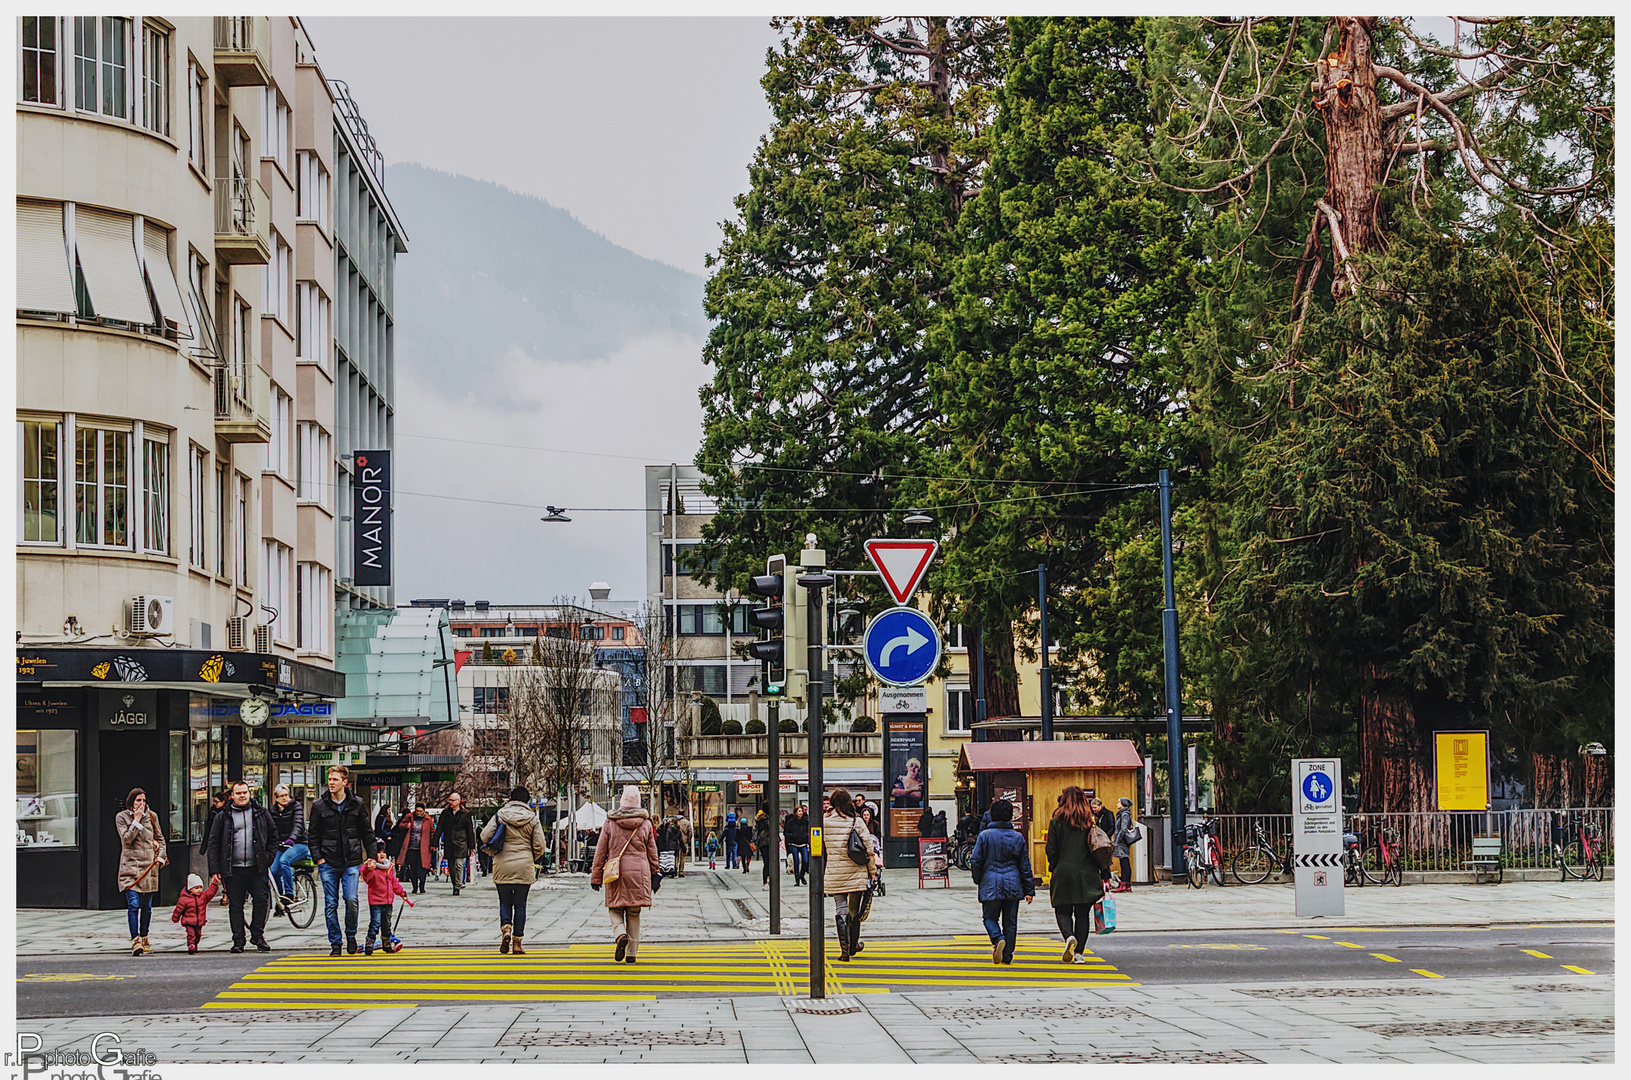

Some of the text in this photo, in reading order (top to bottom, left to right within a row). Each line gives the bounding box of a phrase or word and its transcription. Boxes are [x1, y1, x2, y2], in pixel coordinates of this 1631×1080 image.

[362, 467, 382, 569] MANOR
[21, 657, 47, 666] Juwelen
[19, 667, 35, 675] 1923
[882, 691, 924, 699] Ausgenommen
[110, 710, 147, 725] JÄGGI
[364, 776, 397, 784] MANOR
